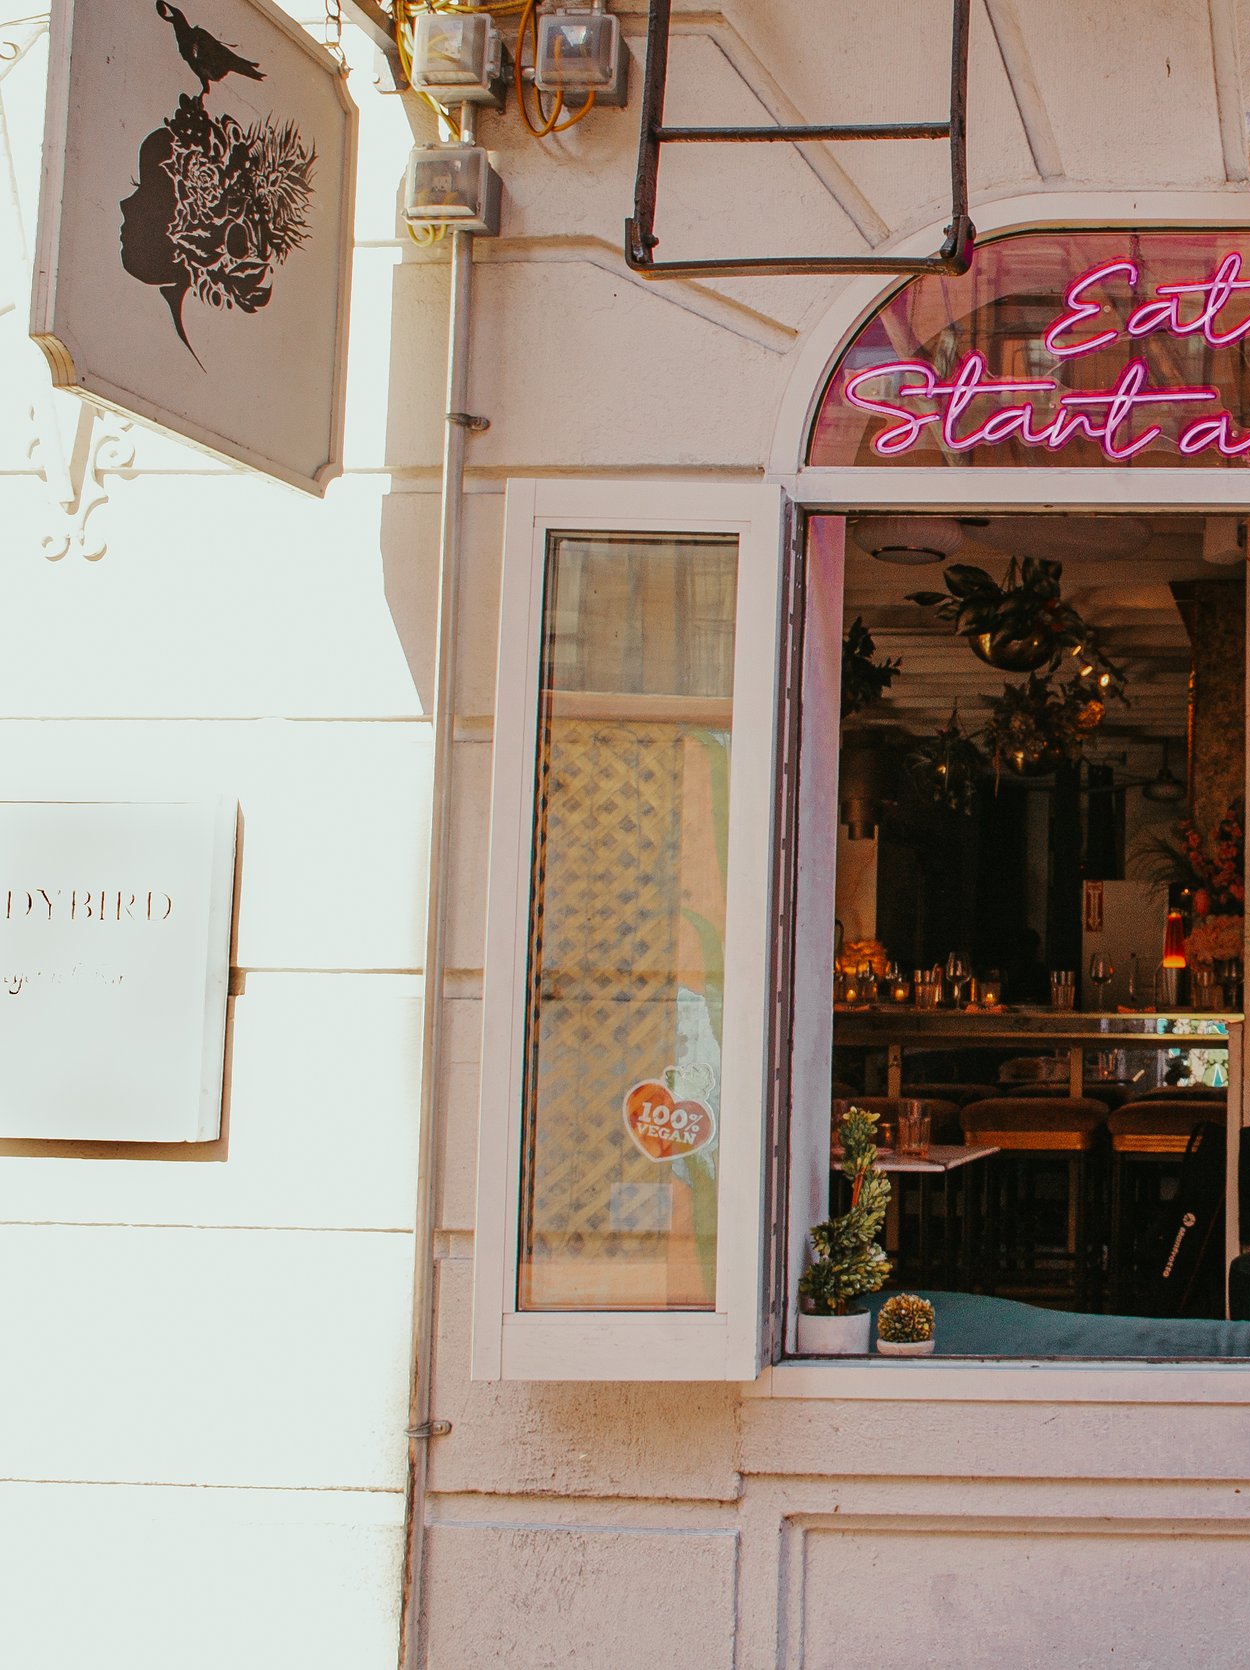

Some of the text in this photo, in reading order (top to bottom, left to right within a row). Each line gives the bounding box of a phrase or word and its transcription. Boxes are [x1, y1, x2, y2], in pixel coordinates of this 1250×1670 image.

[845, 350, 1216, 460] Start
[4, 888, 173, 921] DYBIRD
[637, 1101, 704, 1132] 100%
[636, 1122, 698, 1145] VEGAN
